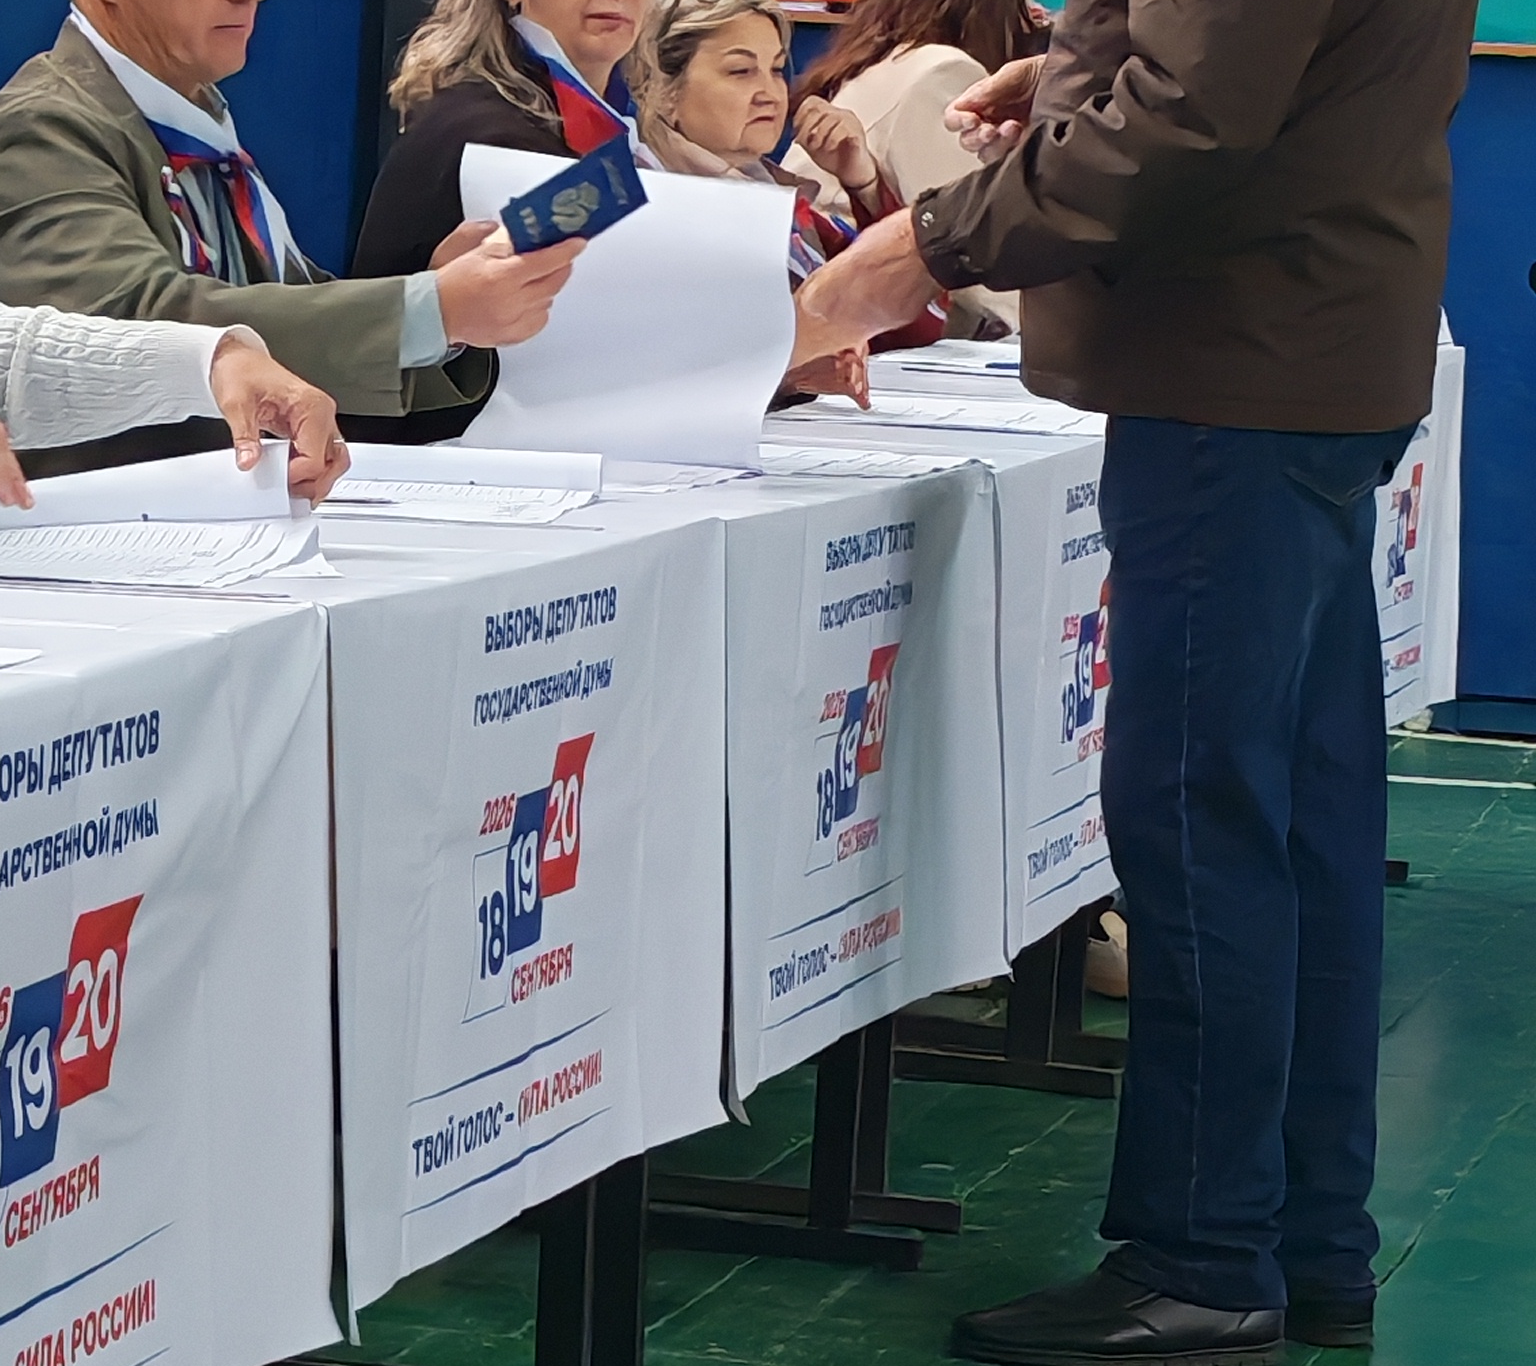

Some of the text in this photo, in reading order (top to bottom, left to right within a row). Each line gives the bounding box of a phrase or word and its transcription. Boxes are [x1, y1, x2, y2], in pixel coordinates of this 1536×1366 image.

[485, 586, 617, 653] ВЫБОРЫ ДЕПУТАТОВ
[1095, 605, 1108, 663] 2
[474, 660, 582, 726] ГОСУДАРСТВЕННОЙ
[863, 675, 889, 746] 20
[1061, 683, 1075, 743] 18
[47, 710, 161, 795] ДЕПУТАТОВ
[840, 720, 861, 791] 19
[112, 798, 160, 857] ДУМЫ
[479, 793, 515, 836] 2026
[542, 773, 579, 862] 20
[816, 768, 834, 841] 18
[510, 830, 539, 917] 19
[479, 891, 505, 979] 18
[61, 948, 118, 1064] 20
[511, 942, 573, 1004] СЕНТЯБРЯ
[5, 1026, 53, 1140] 19
[412, 1114, 454, 1177] ТВОЙ
[456, 1101, 504, 1159] ГОЛОС
[4, 1155, 100, 1248] СЕНТЯБРЯ
[71, 1279, 156, 1363] РОССИИ!
